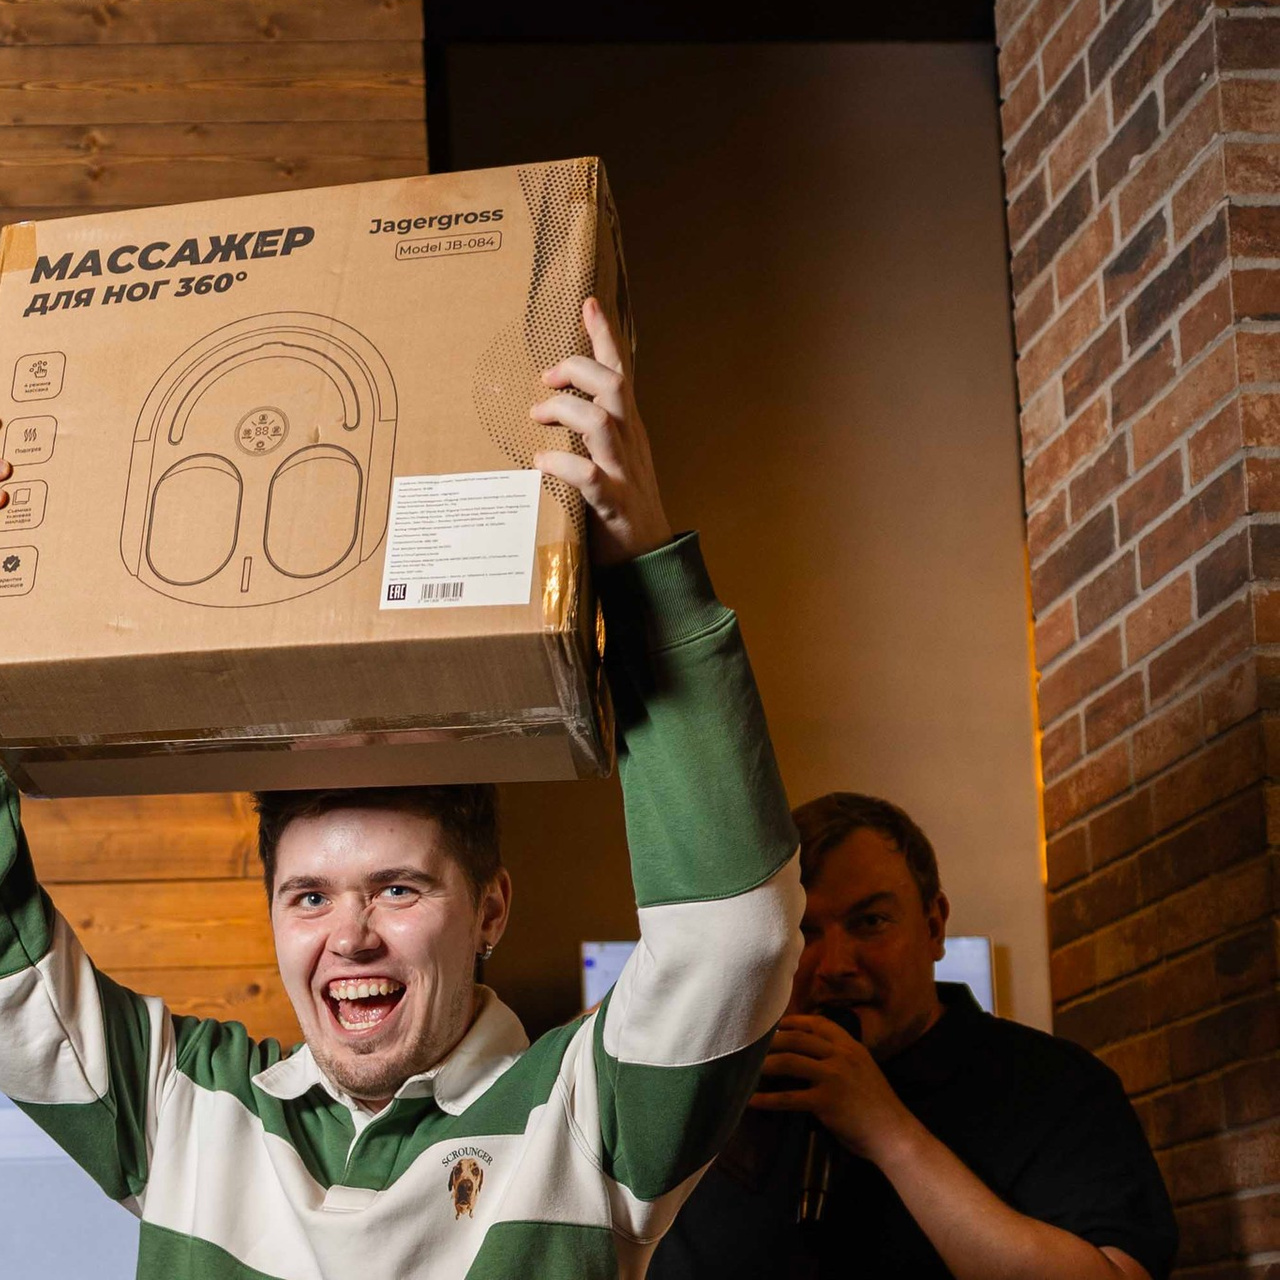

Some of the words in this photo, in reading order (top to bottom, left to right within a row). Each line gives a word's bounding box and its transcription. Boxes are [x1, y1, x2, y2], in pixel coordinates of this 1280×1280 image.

[369, 208, 504, 235] Jagergross
[29, 226, 316, 284] МАССАЖЕР
[399, 242, 442, 256] Model
[444, 236, 496, 252] JB-084
[22, 287, 96, 318] ДЛЯ
[101, 279, 171, 306] НОГ
[173, 270, 248, 298] 360°
[441, 1147, 494, 1168] SCROUNGER
